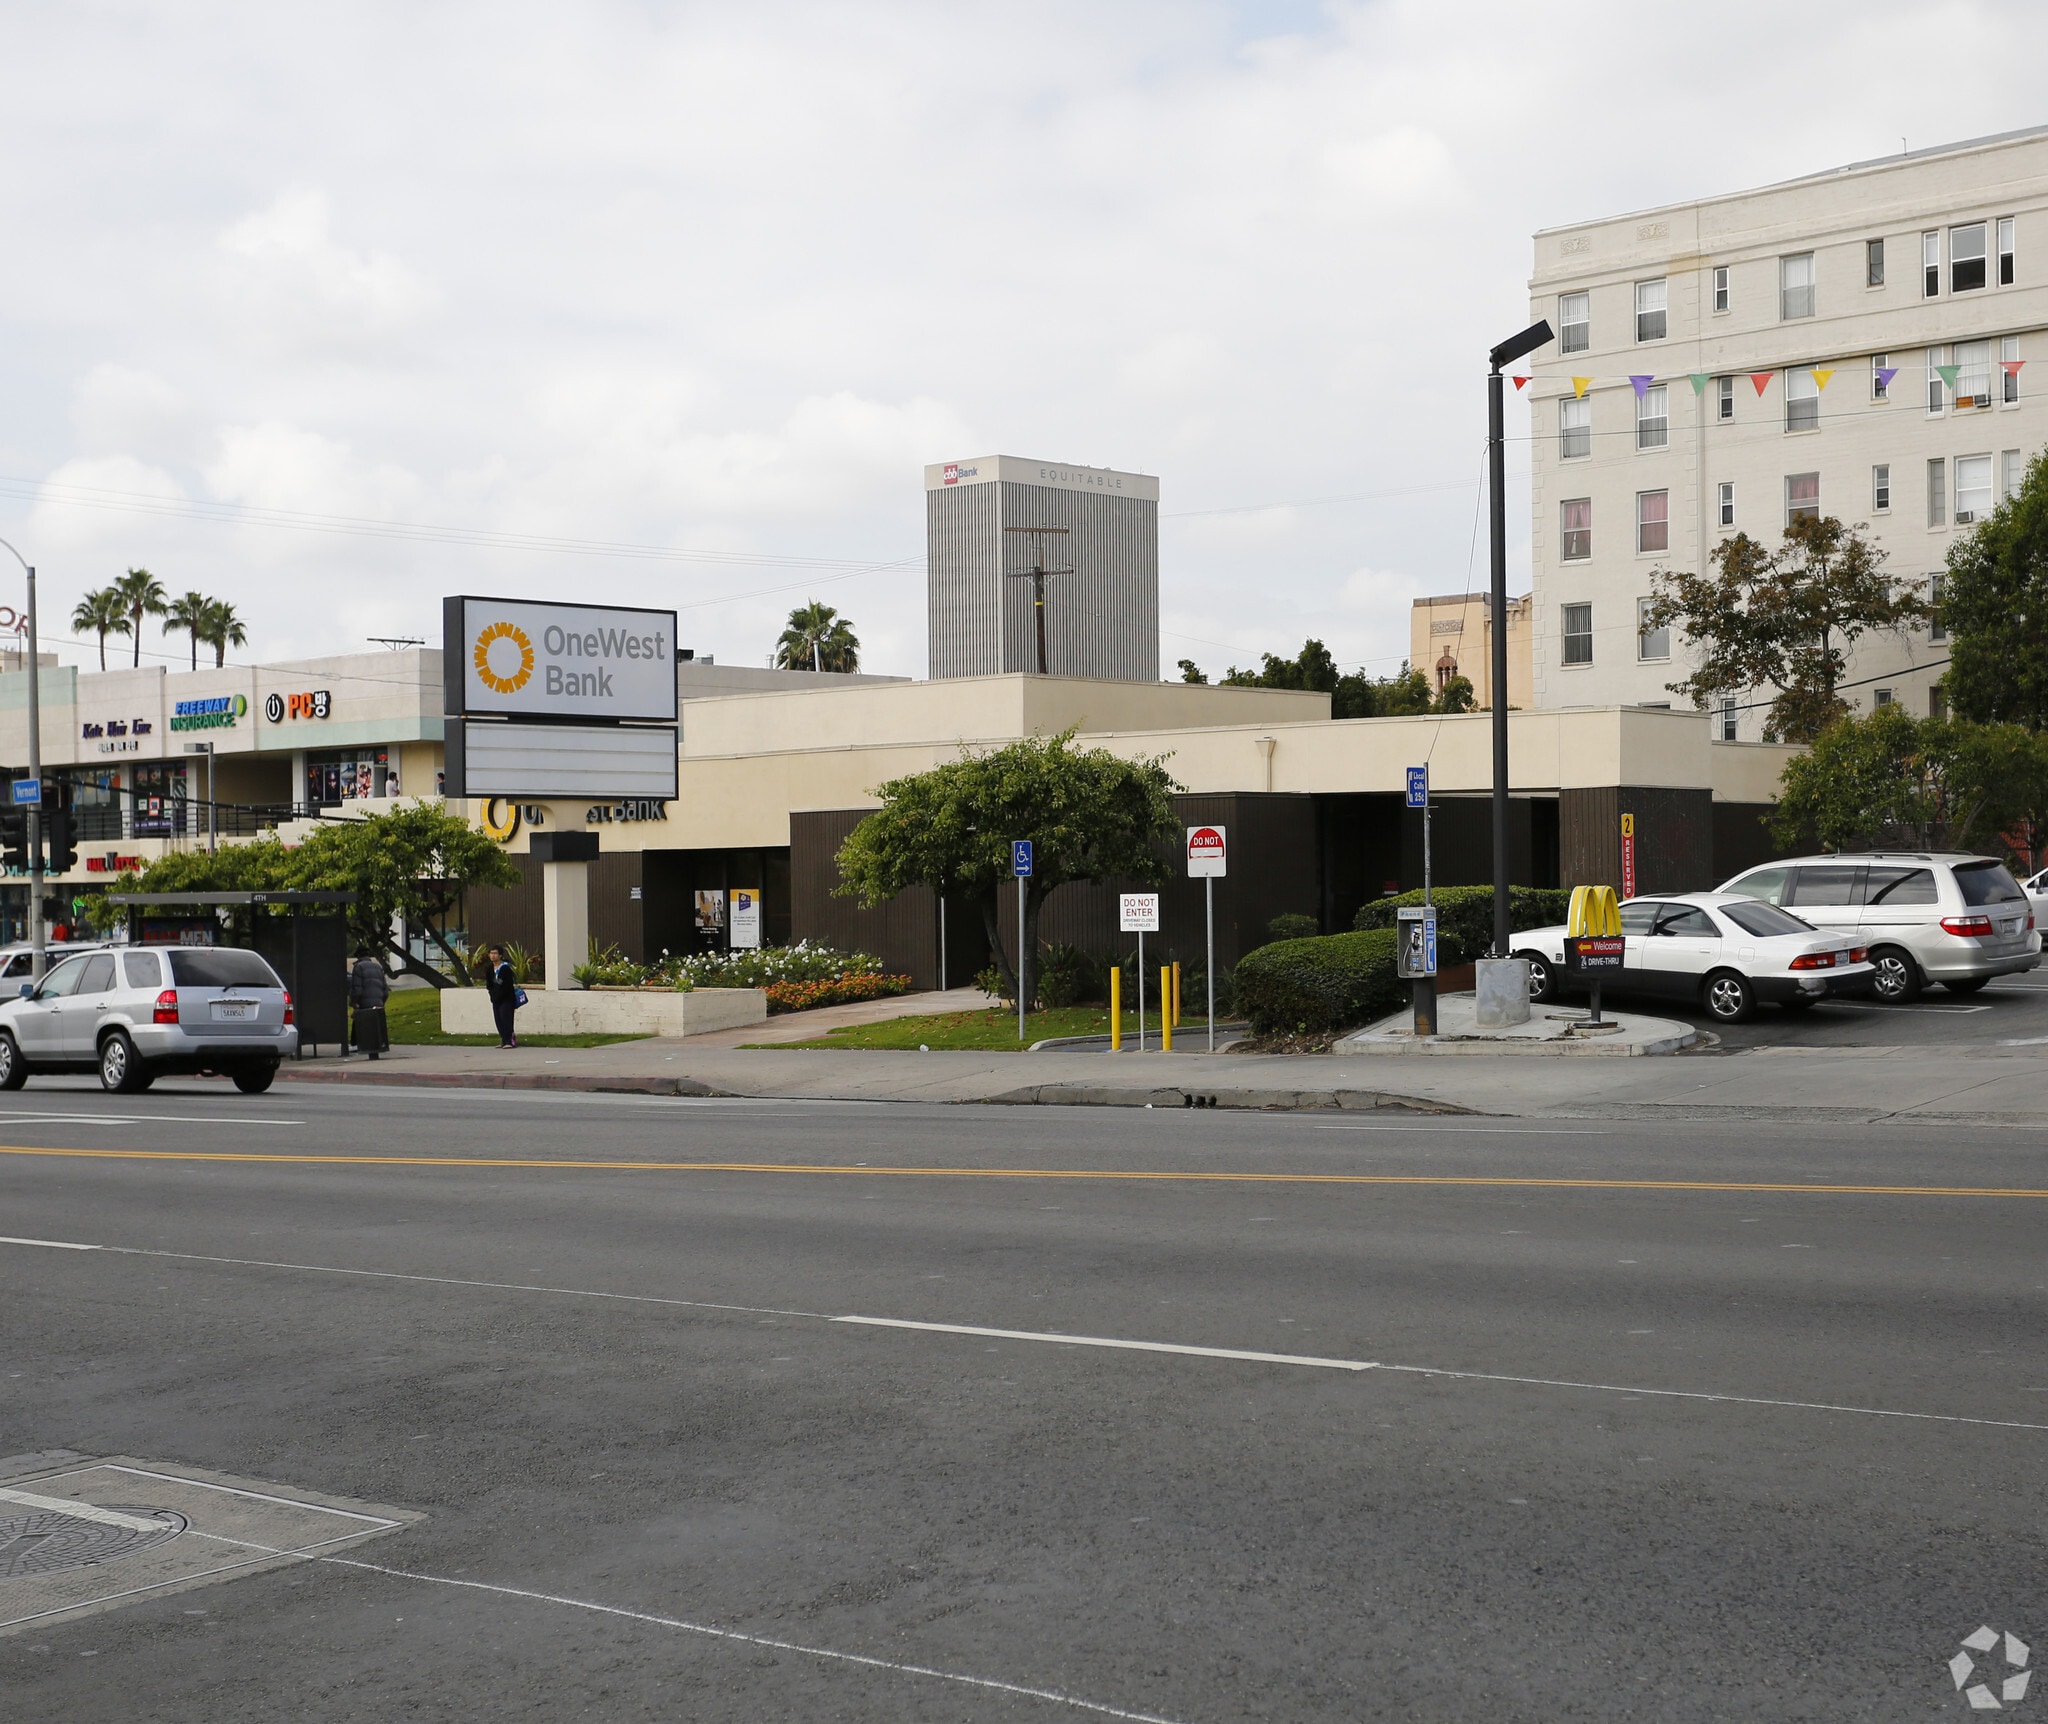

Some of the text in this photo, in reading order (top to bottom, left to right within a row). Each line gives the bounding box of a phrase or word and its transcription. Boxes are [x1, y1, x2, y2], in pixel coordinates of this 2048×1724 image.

[958, 467, 978, 478] Bank
[1040, 469, 1122, 488] EQUITABLE
[544, 625, 665, 660] OneWest
[546, 666, 614, 697] Bank
[175, 697, 231, 715] FREEWAY
[170, 712, 236, 731] INSURANCE
[1413, 771, 1425, 780] Local
[1413, 781, 1425, 790] Calls
[16, 785, 37, 798] Vermont
[1624, 817, 1631, 834] 2
[1193, 836, 1219, 846] DO NOT
[253, 894, 267, 902] 4TH
[1123, 898, 1155, 907] DO NOT
[1126, 908, 1153, 917] ENTER
[1593, 941, 1623, 951] Welcome
[1588, 957, 1620, 966] DRIVE-THRU
